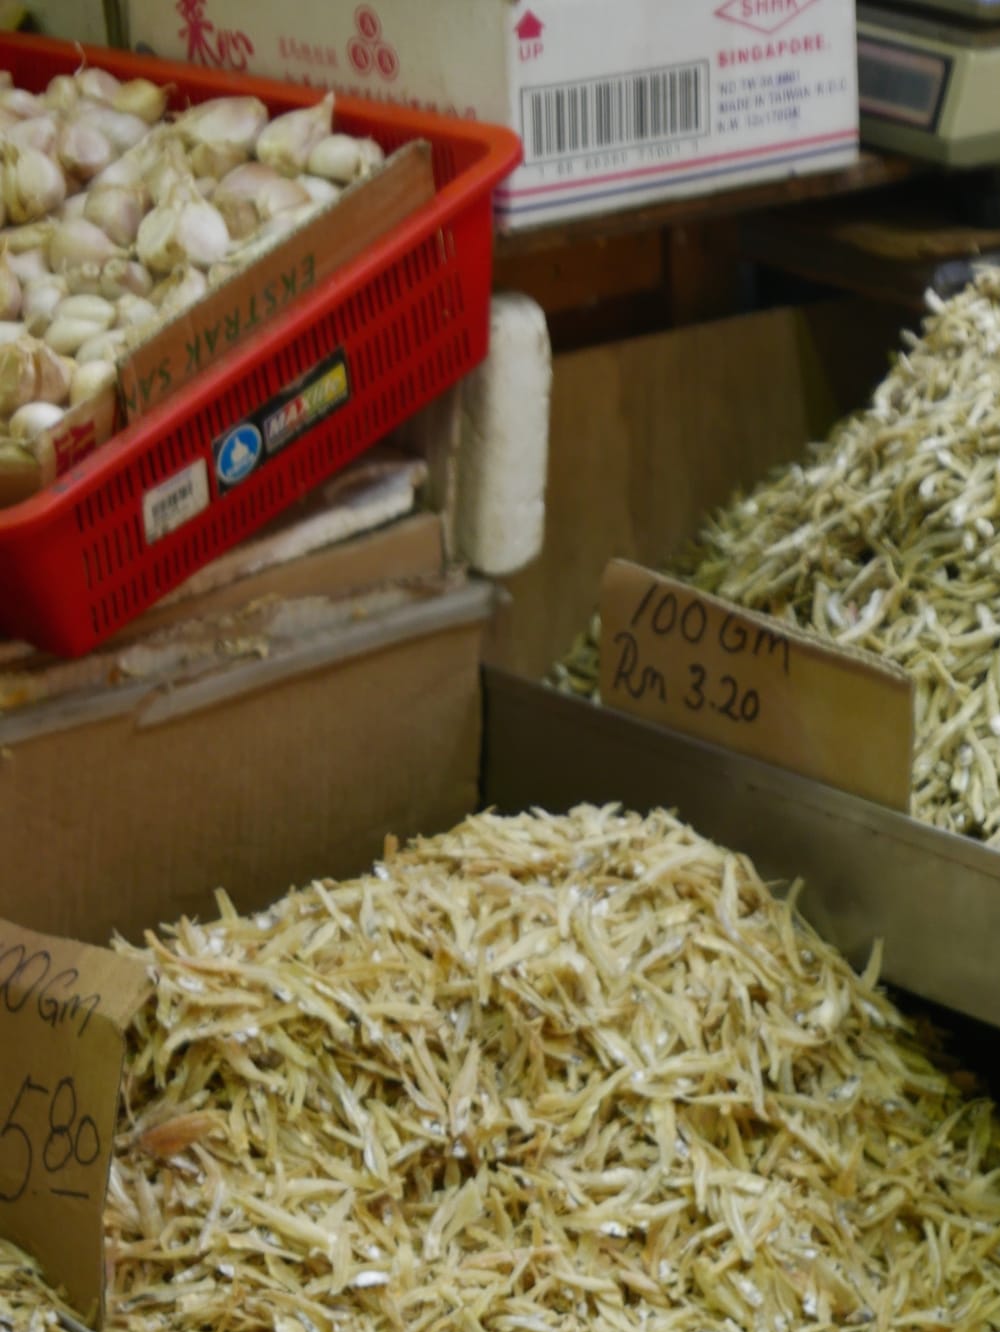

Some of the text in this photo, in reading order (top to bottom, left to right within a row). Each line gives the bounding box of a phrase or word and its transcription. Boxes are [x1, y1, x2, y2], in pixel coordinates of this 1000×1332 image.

[518, 43, 544, 62] UP
[185, 255, 315, 372] EKSTRAK
[684, 663, 760, 722] 3.20
